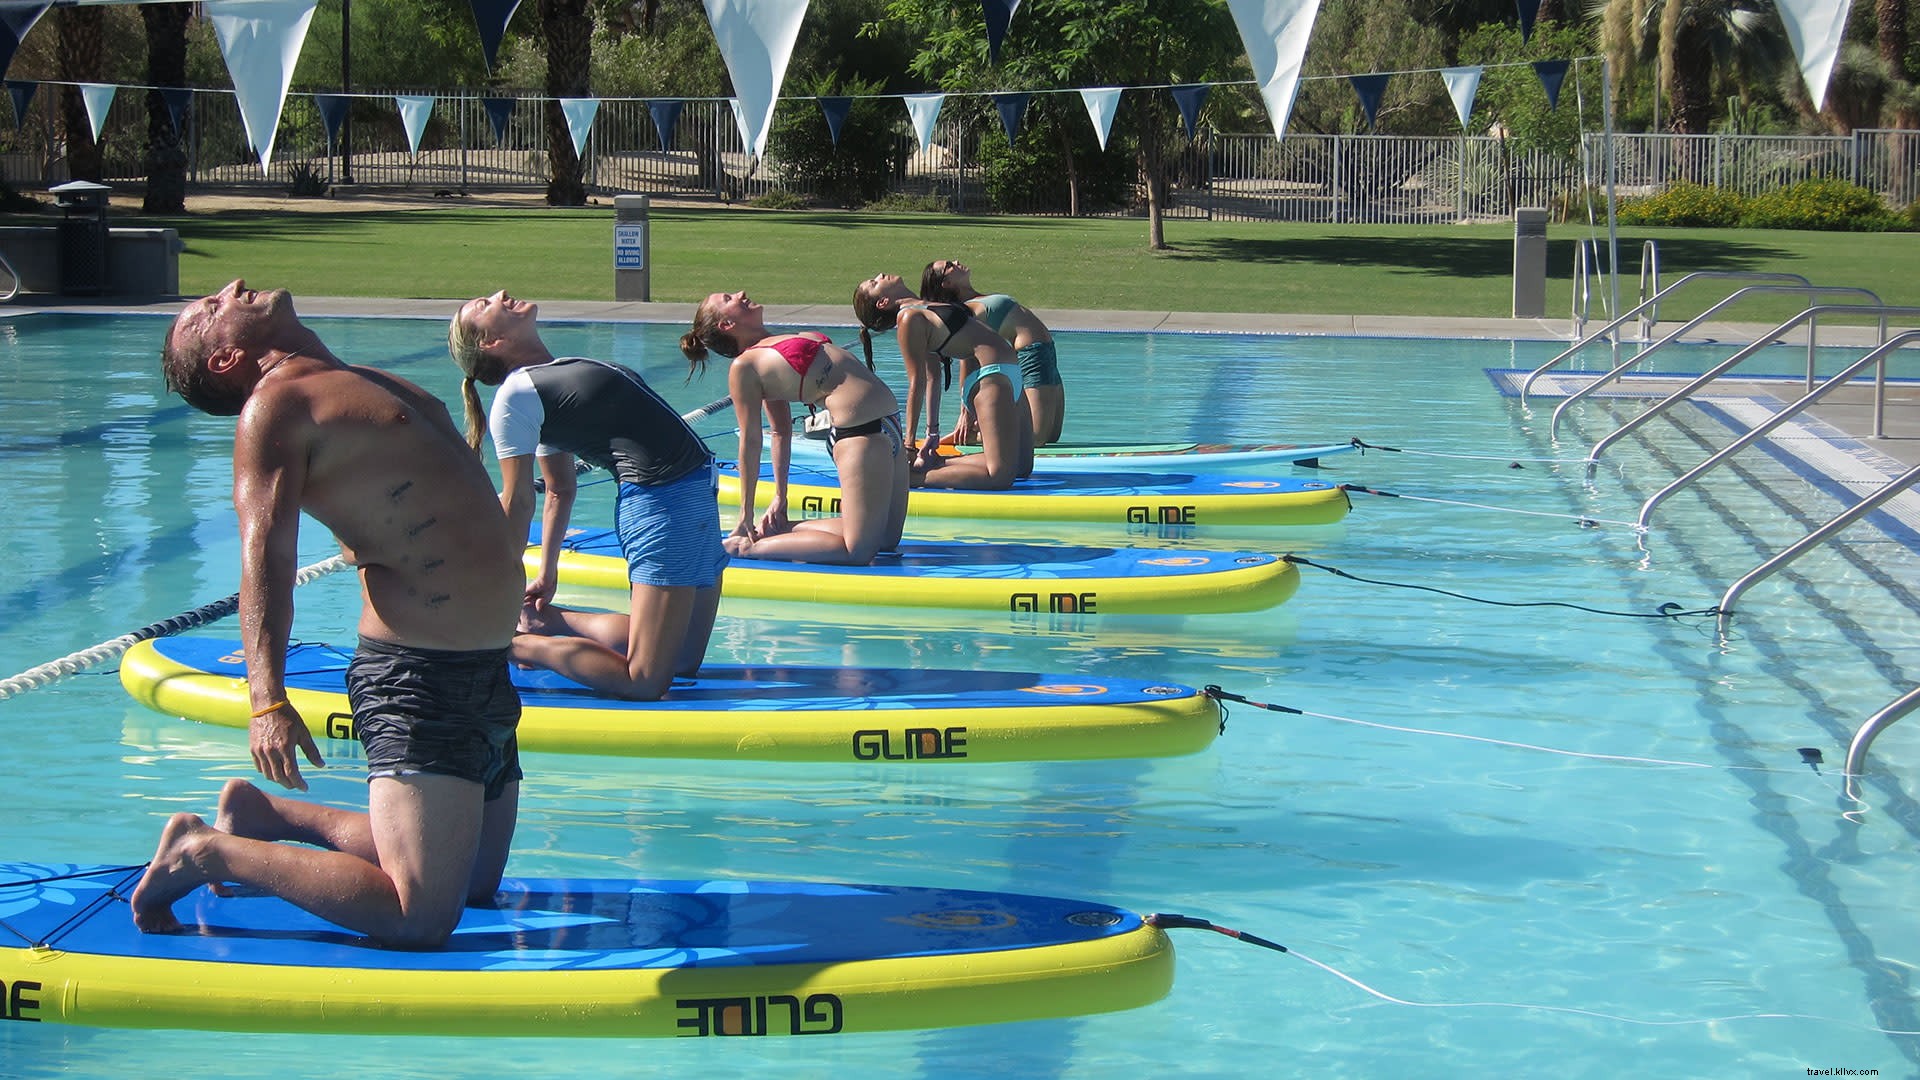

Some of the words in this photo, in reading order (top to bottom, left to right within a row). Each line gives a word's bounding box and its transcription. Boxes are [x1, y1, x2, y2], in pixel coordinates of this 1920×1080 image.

[1127, 506, 1196, 525] GLIDE
[852, 727, 967, 761] GLIDE
[676, 993, 843, 1037] GLIDE
